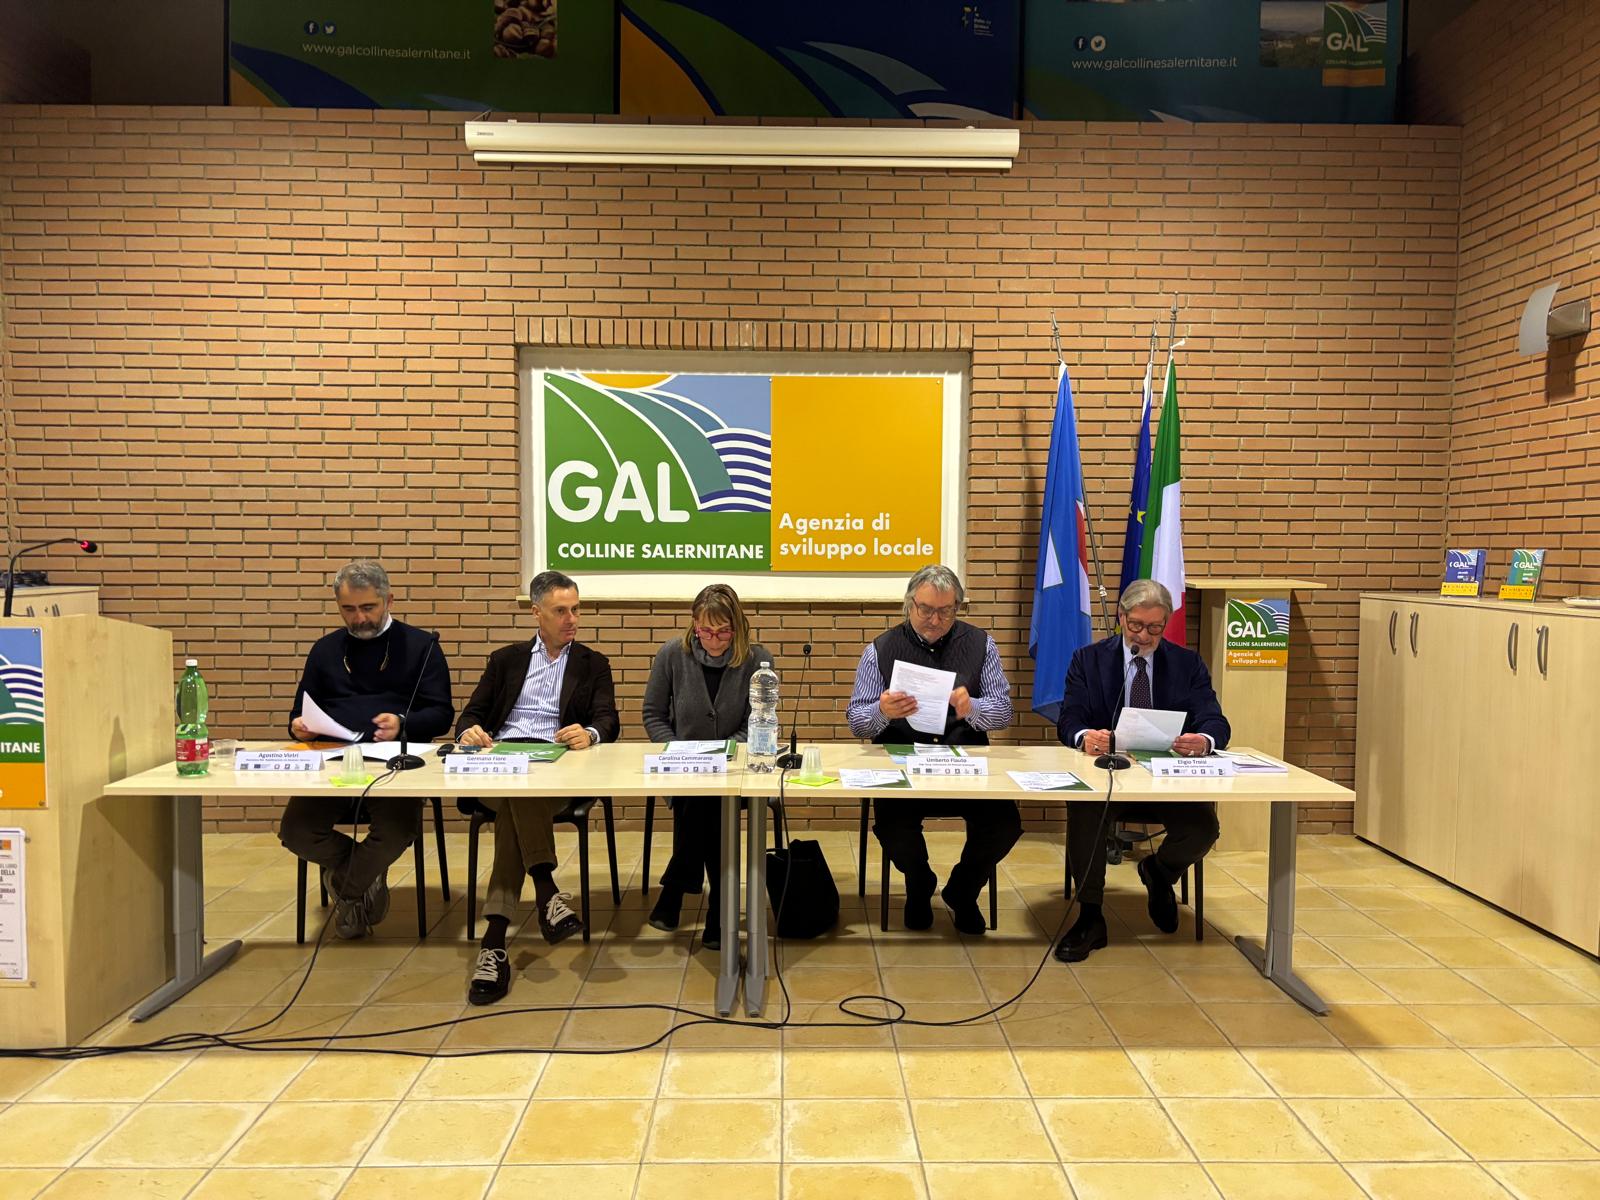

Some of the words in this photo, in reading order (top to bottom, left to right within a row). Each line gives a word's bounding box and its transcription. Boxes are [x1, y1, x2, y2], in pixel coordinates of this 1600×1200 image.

[302, 42, 471, 60] www.galcollinesalernitane.it
[1327, 32, 1368, 52] GAL
[1071, 56, 1238, 71] www.galcollinesalernitane.it
[548, 460, 690, 523] GAL
[779, 513, 865, 534] Agenzia
[871, 513, 890, 531] di
[558, 543, 635, 559] COLLINE
[641, 543, 764, 559] SALERNITANE
[779, 539, 866, 560] sviluppo
[873, 539, 934, 556] locale
[1227, 621, 1266, 638] GAL
